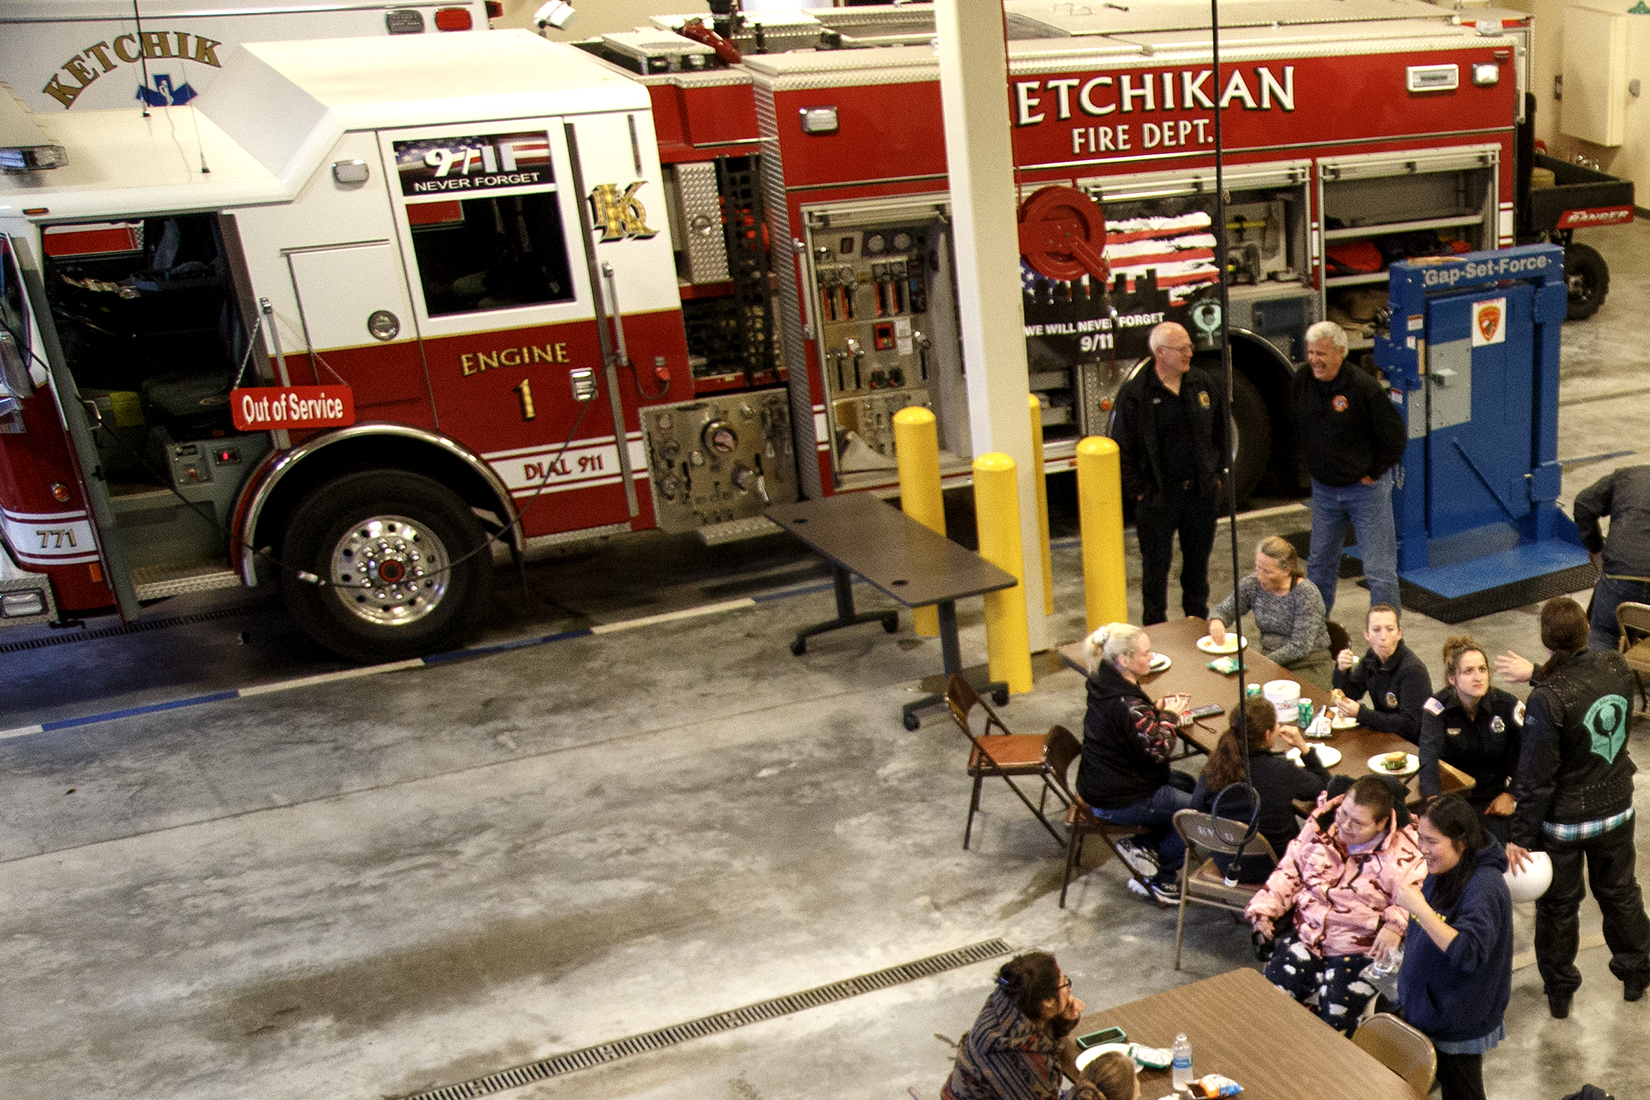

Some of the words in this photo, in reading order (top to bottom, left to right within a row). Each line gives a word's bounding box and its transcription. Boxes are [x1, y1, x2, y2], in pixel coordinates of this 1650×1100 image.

[42, 31, 222, 110] KETCHIK
[1015, 65, 1296, 127] ETCHIKAN
[1071, 124, 1132, 154] FIRE
[1142, 118, 1214, 149] DEPT.
[413, 178, 471, 192] NEVER
[475, 172, 541, 187] FORGET
[1566, 210, 1630, 223] RANGER
[1424, 254, 1548, 287] Gap-Set-Force
[1024, 324, 1044, 337] WE
[1045, 322, 1077, 335] WILL
[1077, 318, 1112, 334] NEVE
[1118, 312, 1165, 328] FORGET
[1080, 333, 1114, 352] 9/11
[461, 342, 570, 377] ENGINE
[242, 393, 271, 423] Out
[272, 392, 289, 421] of
[290, 391, 344, 420] Service
[512, 378, 536, 422] 1
[524, 458, 572, 482] DIAL
[577, 454, 604, 473] 911
[36, 528, 77, 549] 771
